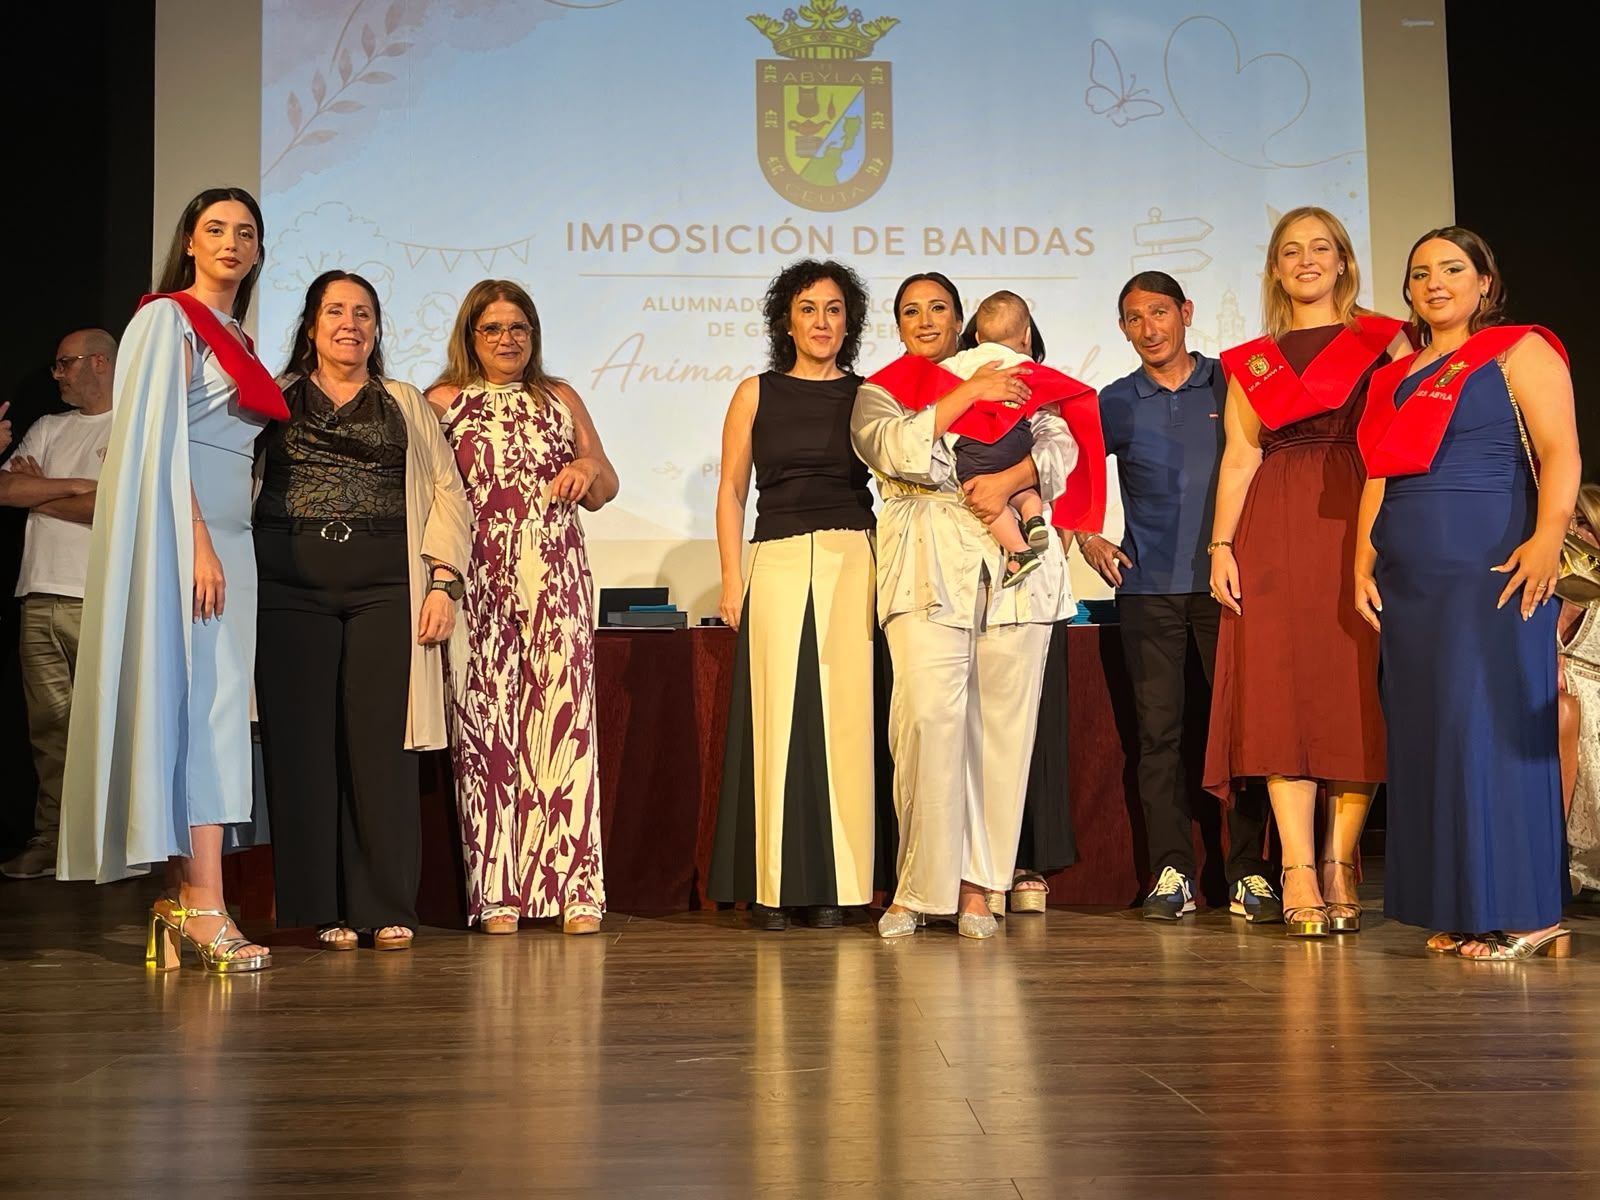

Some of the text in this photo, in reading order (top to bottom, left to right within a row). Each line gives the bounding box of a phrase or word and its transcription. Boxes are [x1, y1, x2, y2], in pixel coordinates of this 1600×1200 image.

[782, 71, 865, 83] ABYLA
[566, 217, 1096, 257] IMPOSICIÓN DE BANDAS
[707, 321, 735, 338] DE
[591, 332, 756, 393] Animac
